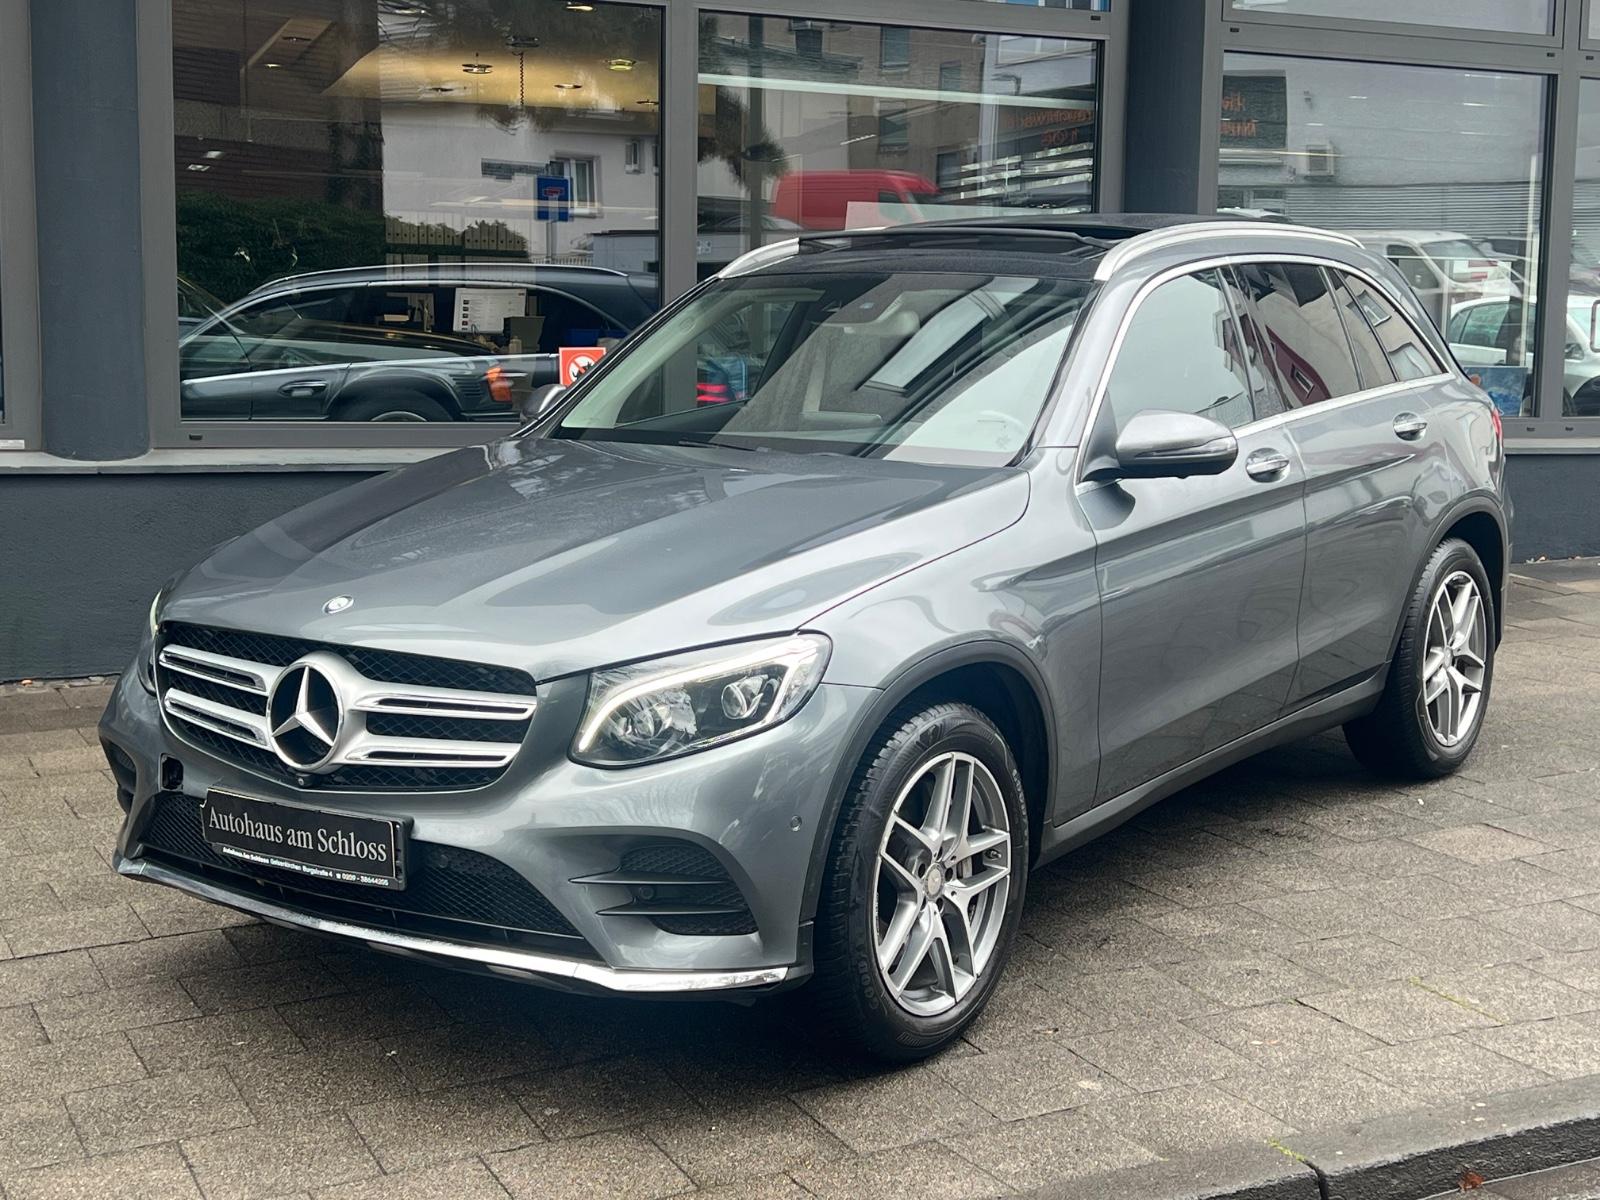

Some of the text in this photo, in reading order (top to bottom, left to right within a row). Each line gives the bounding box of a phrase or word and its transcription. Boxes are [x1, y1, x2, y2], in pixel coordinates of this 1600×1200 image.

[208, 806, 387, 862] Autohaus am Schloss
